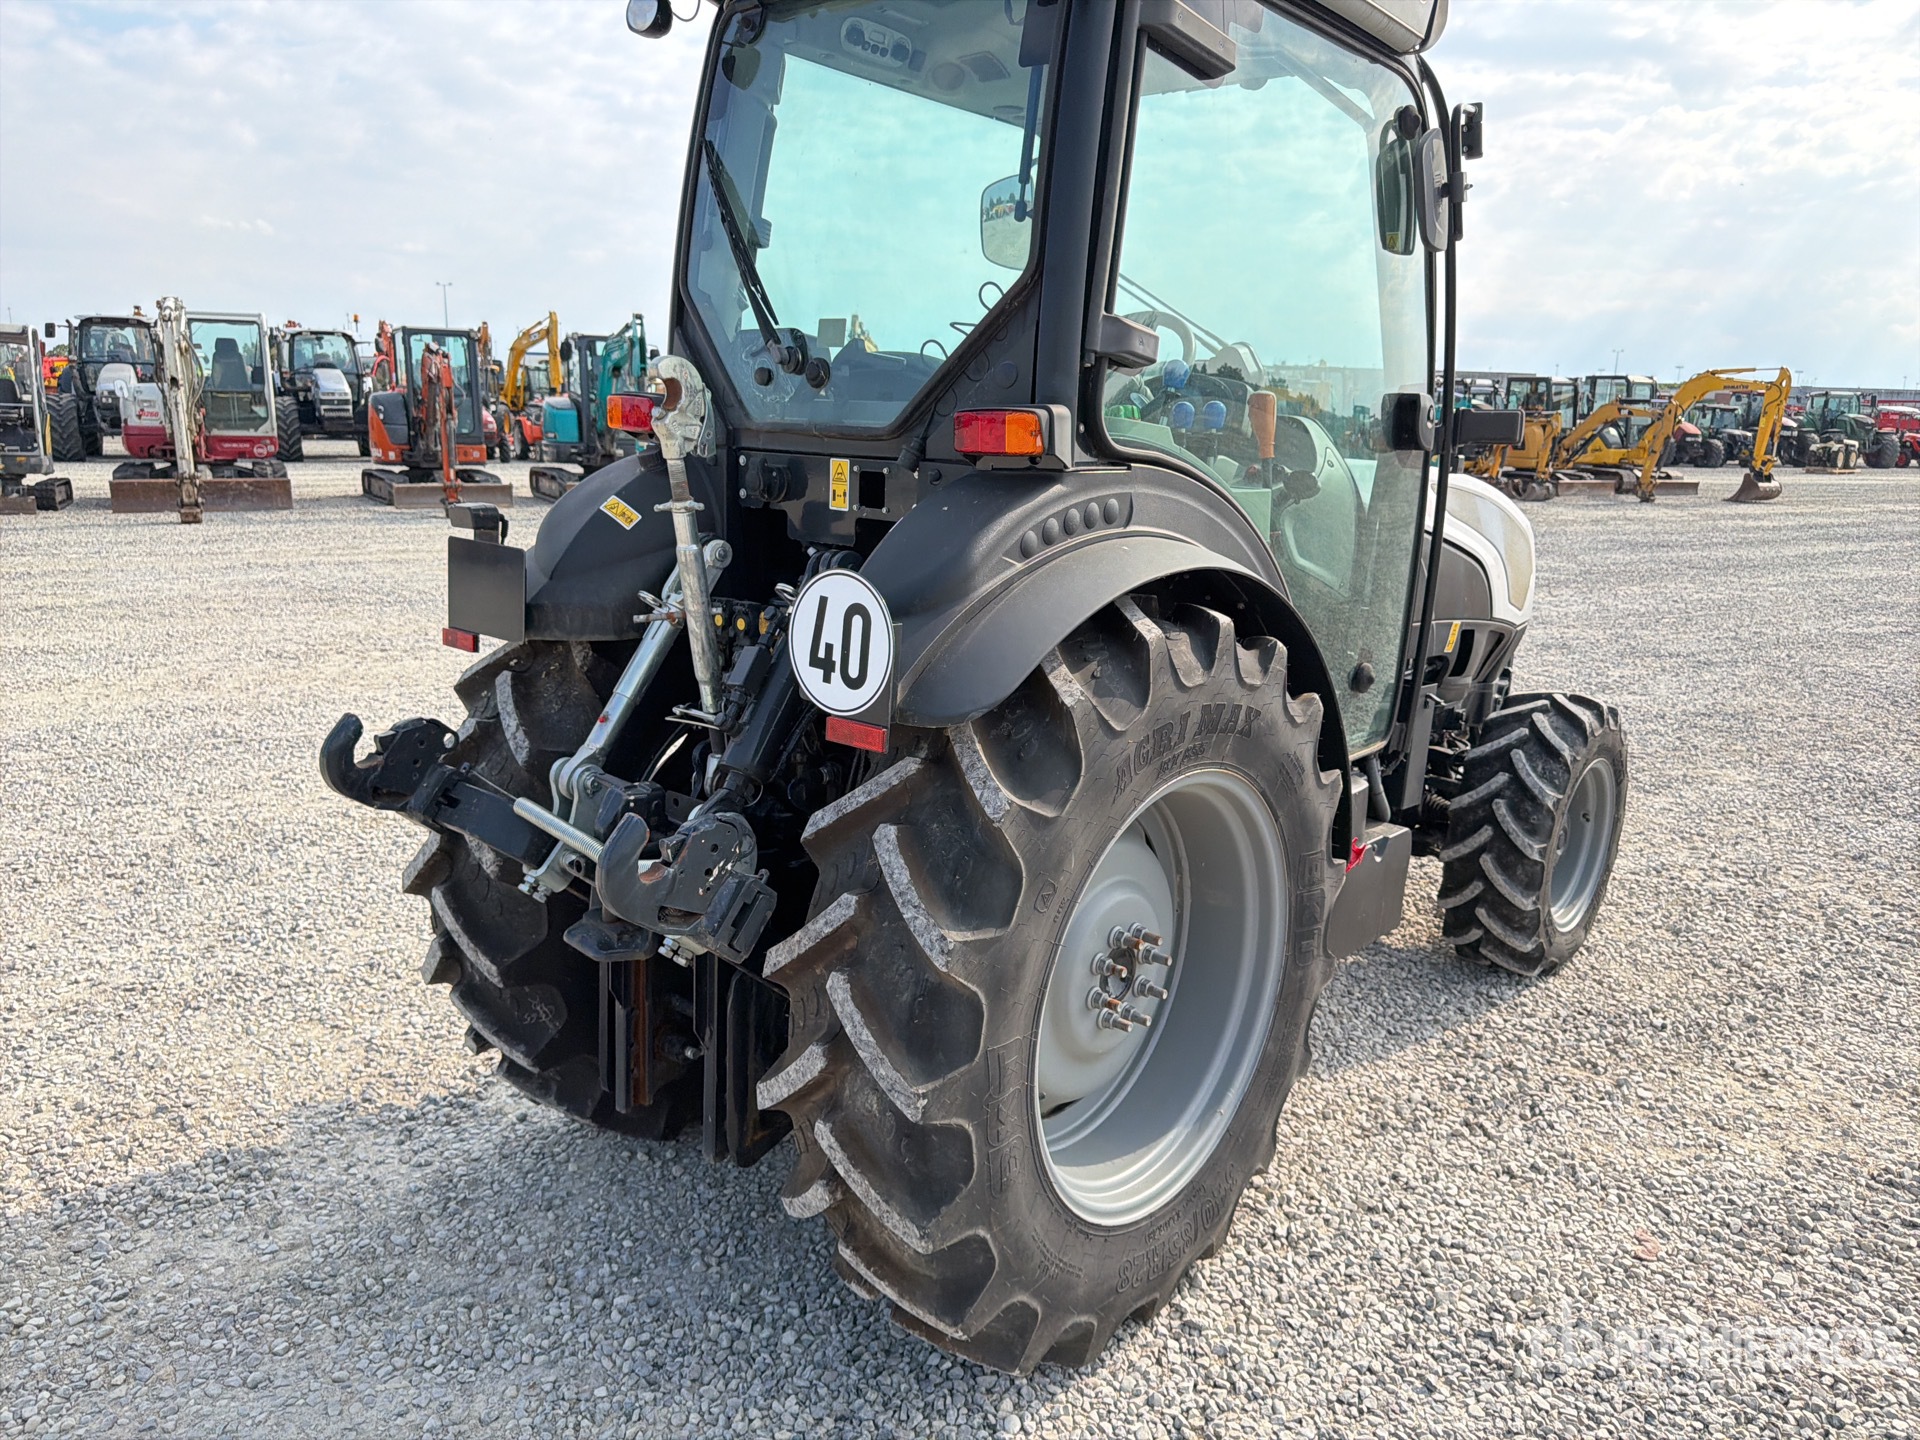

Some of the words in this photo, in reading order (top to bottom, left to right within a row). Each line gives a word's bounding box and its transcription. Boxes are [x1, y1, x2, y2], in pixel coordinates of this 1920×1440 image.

[808, 594, 872, 691] 40
[1113, 710, 1191, 800] AGRI
[1194, 702, 1262, 739] MAX
